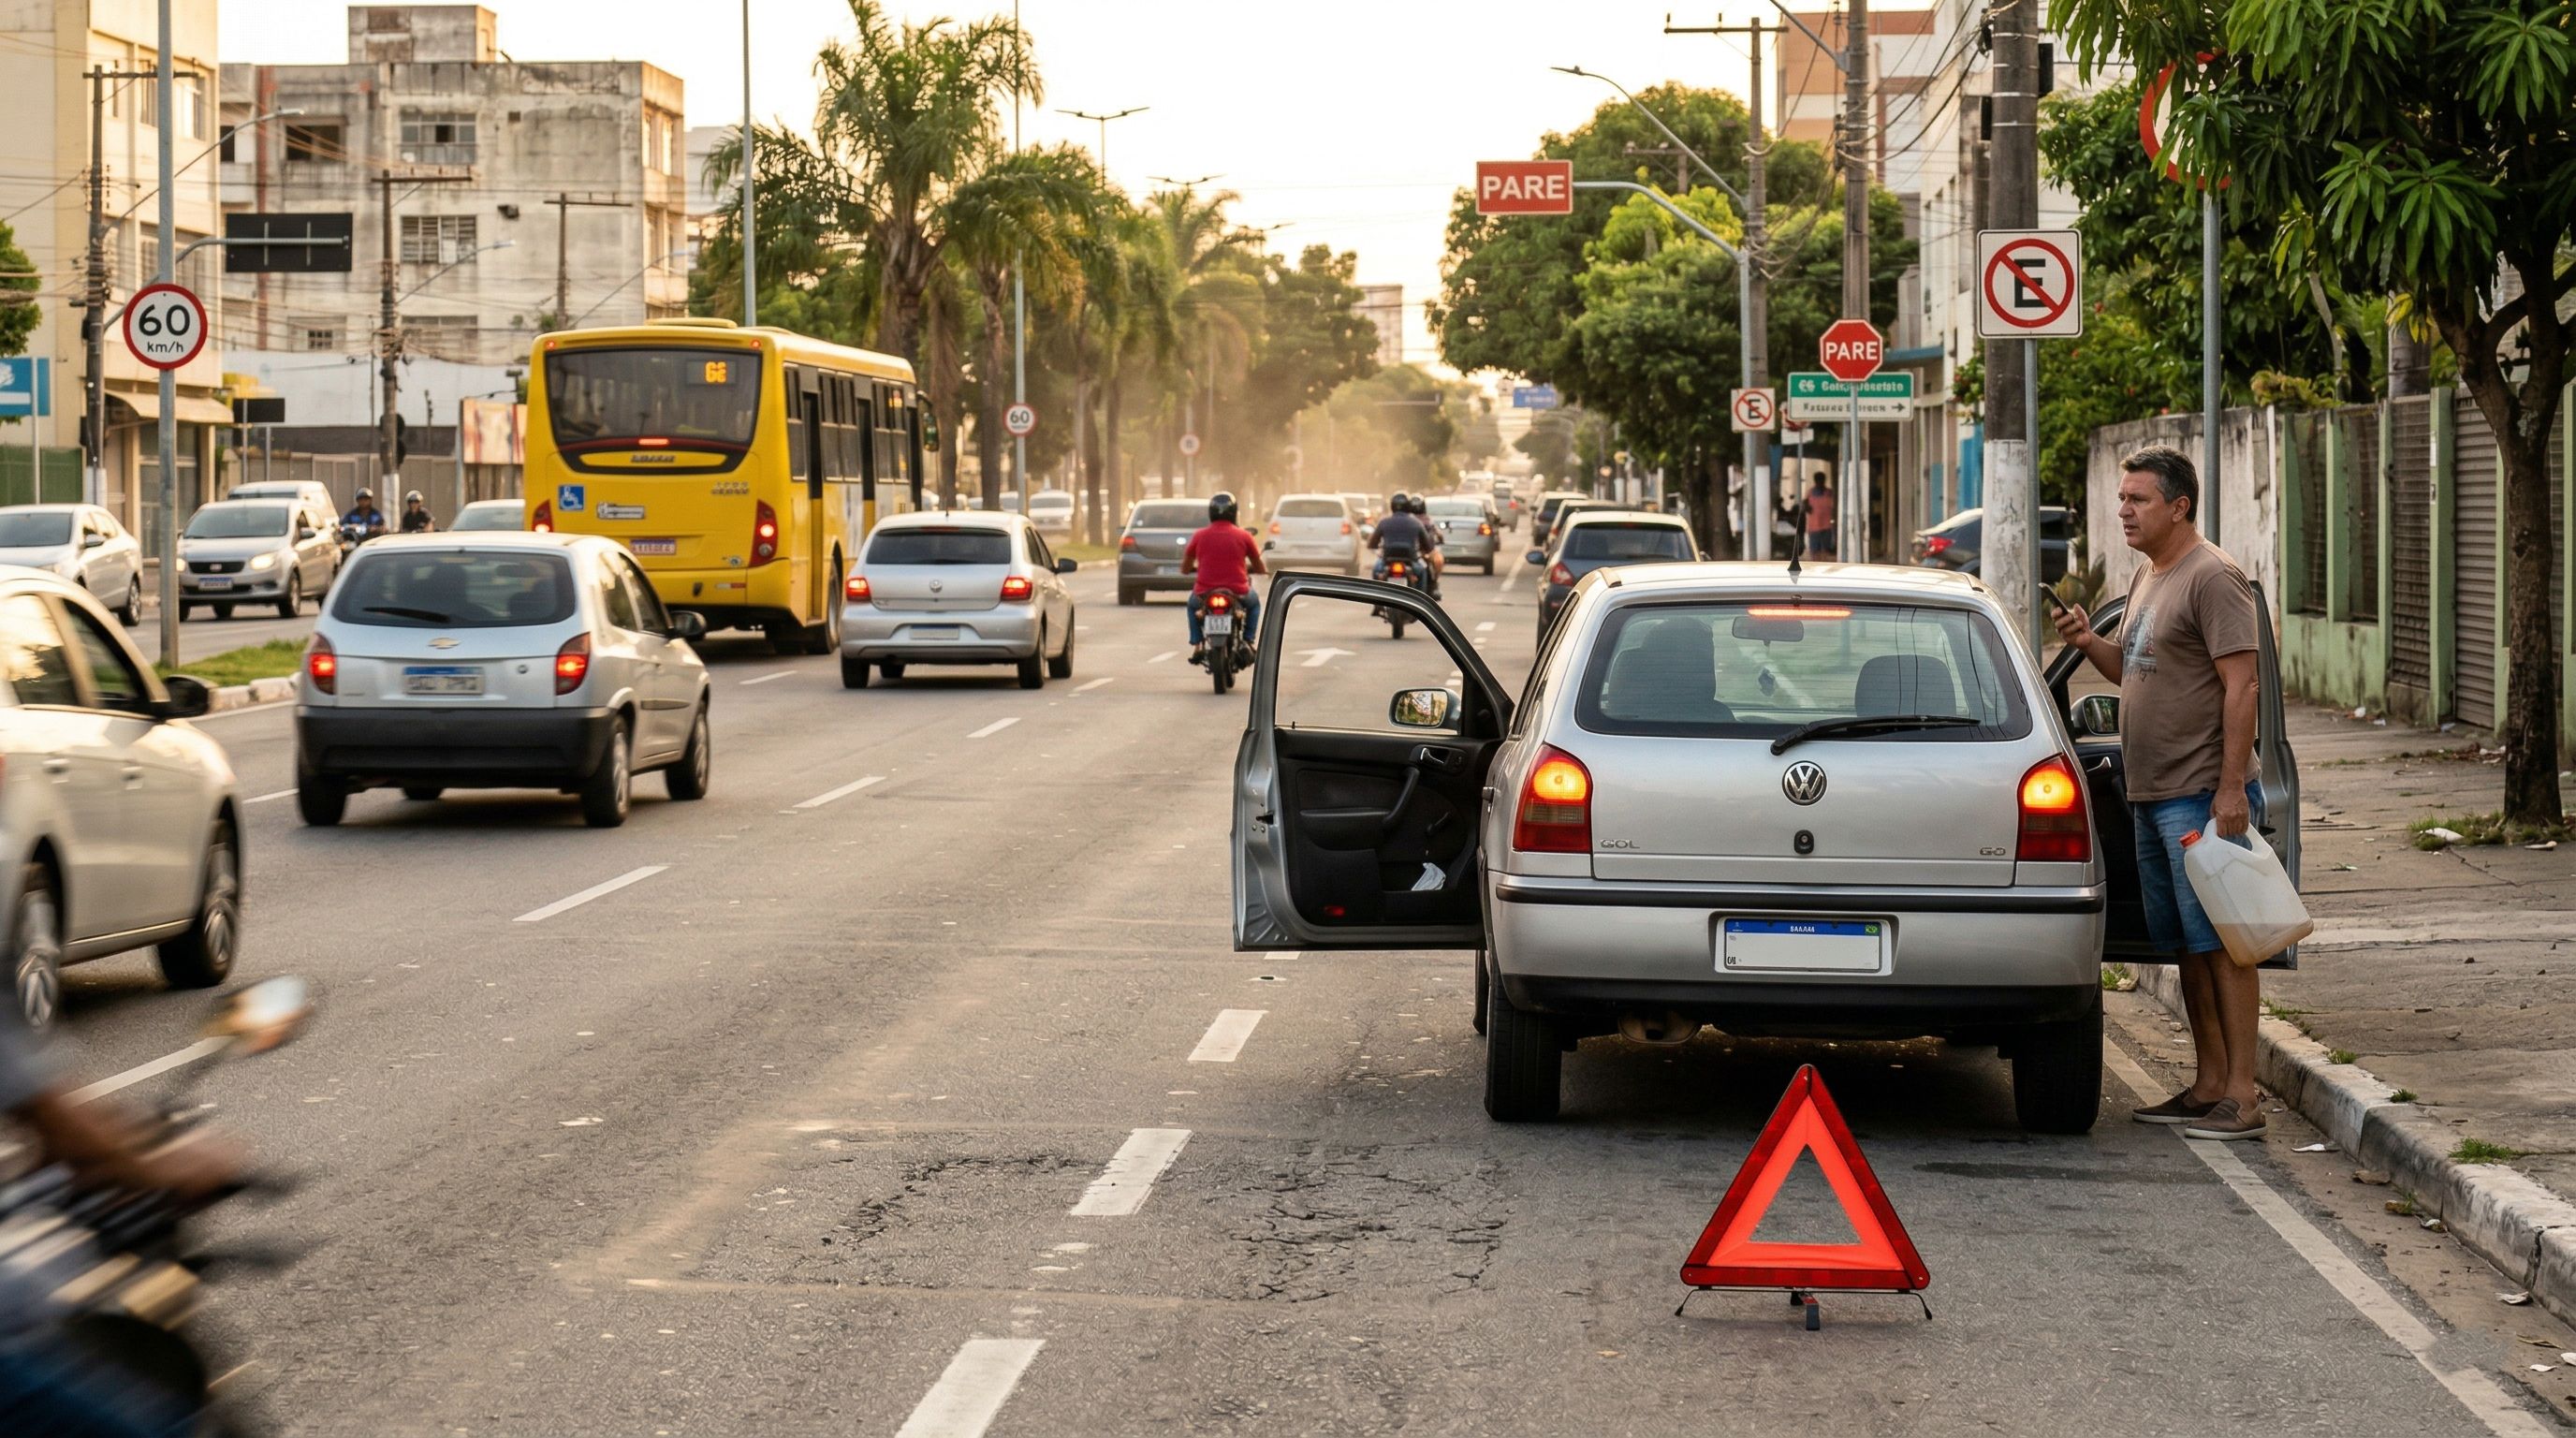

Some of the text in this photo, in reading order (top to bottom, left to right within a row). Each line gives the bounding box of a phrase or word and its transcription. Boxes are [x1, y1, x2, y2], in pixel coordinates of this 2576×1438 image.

[1483, 175, 1566, 200] PARE
[2014, 258, 2047, 308] E
[139, 303, 190, 336] 60
[147, 341, 183, 353] km/h
[1825, 342, 1878, 360] PARE
[1010, 410, 1030, 424] 60
[1748, 398, 1762, 419] E
[1601, 839, 1640, 849] GOL
